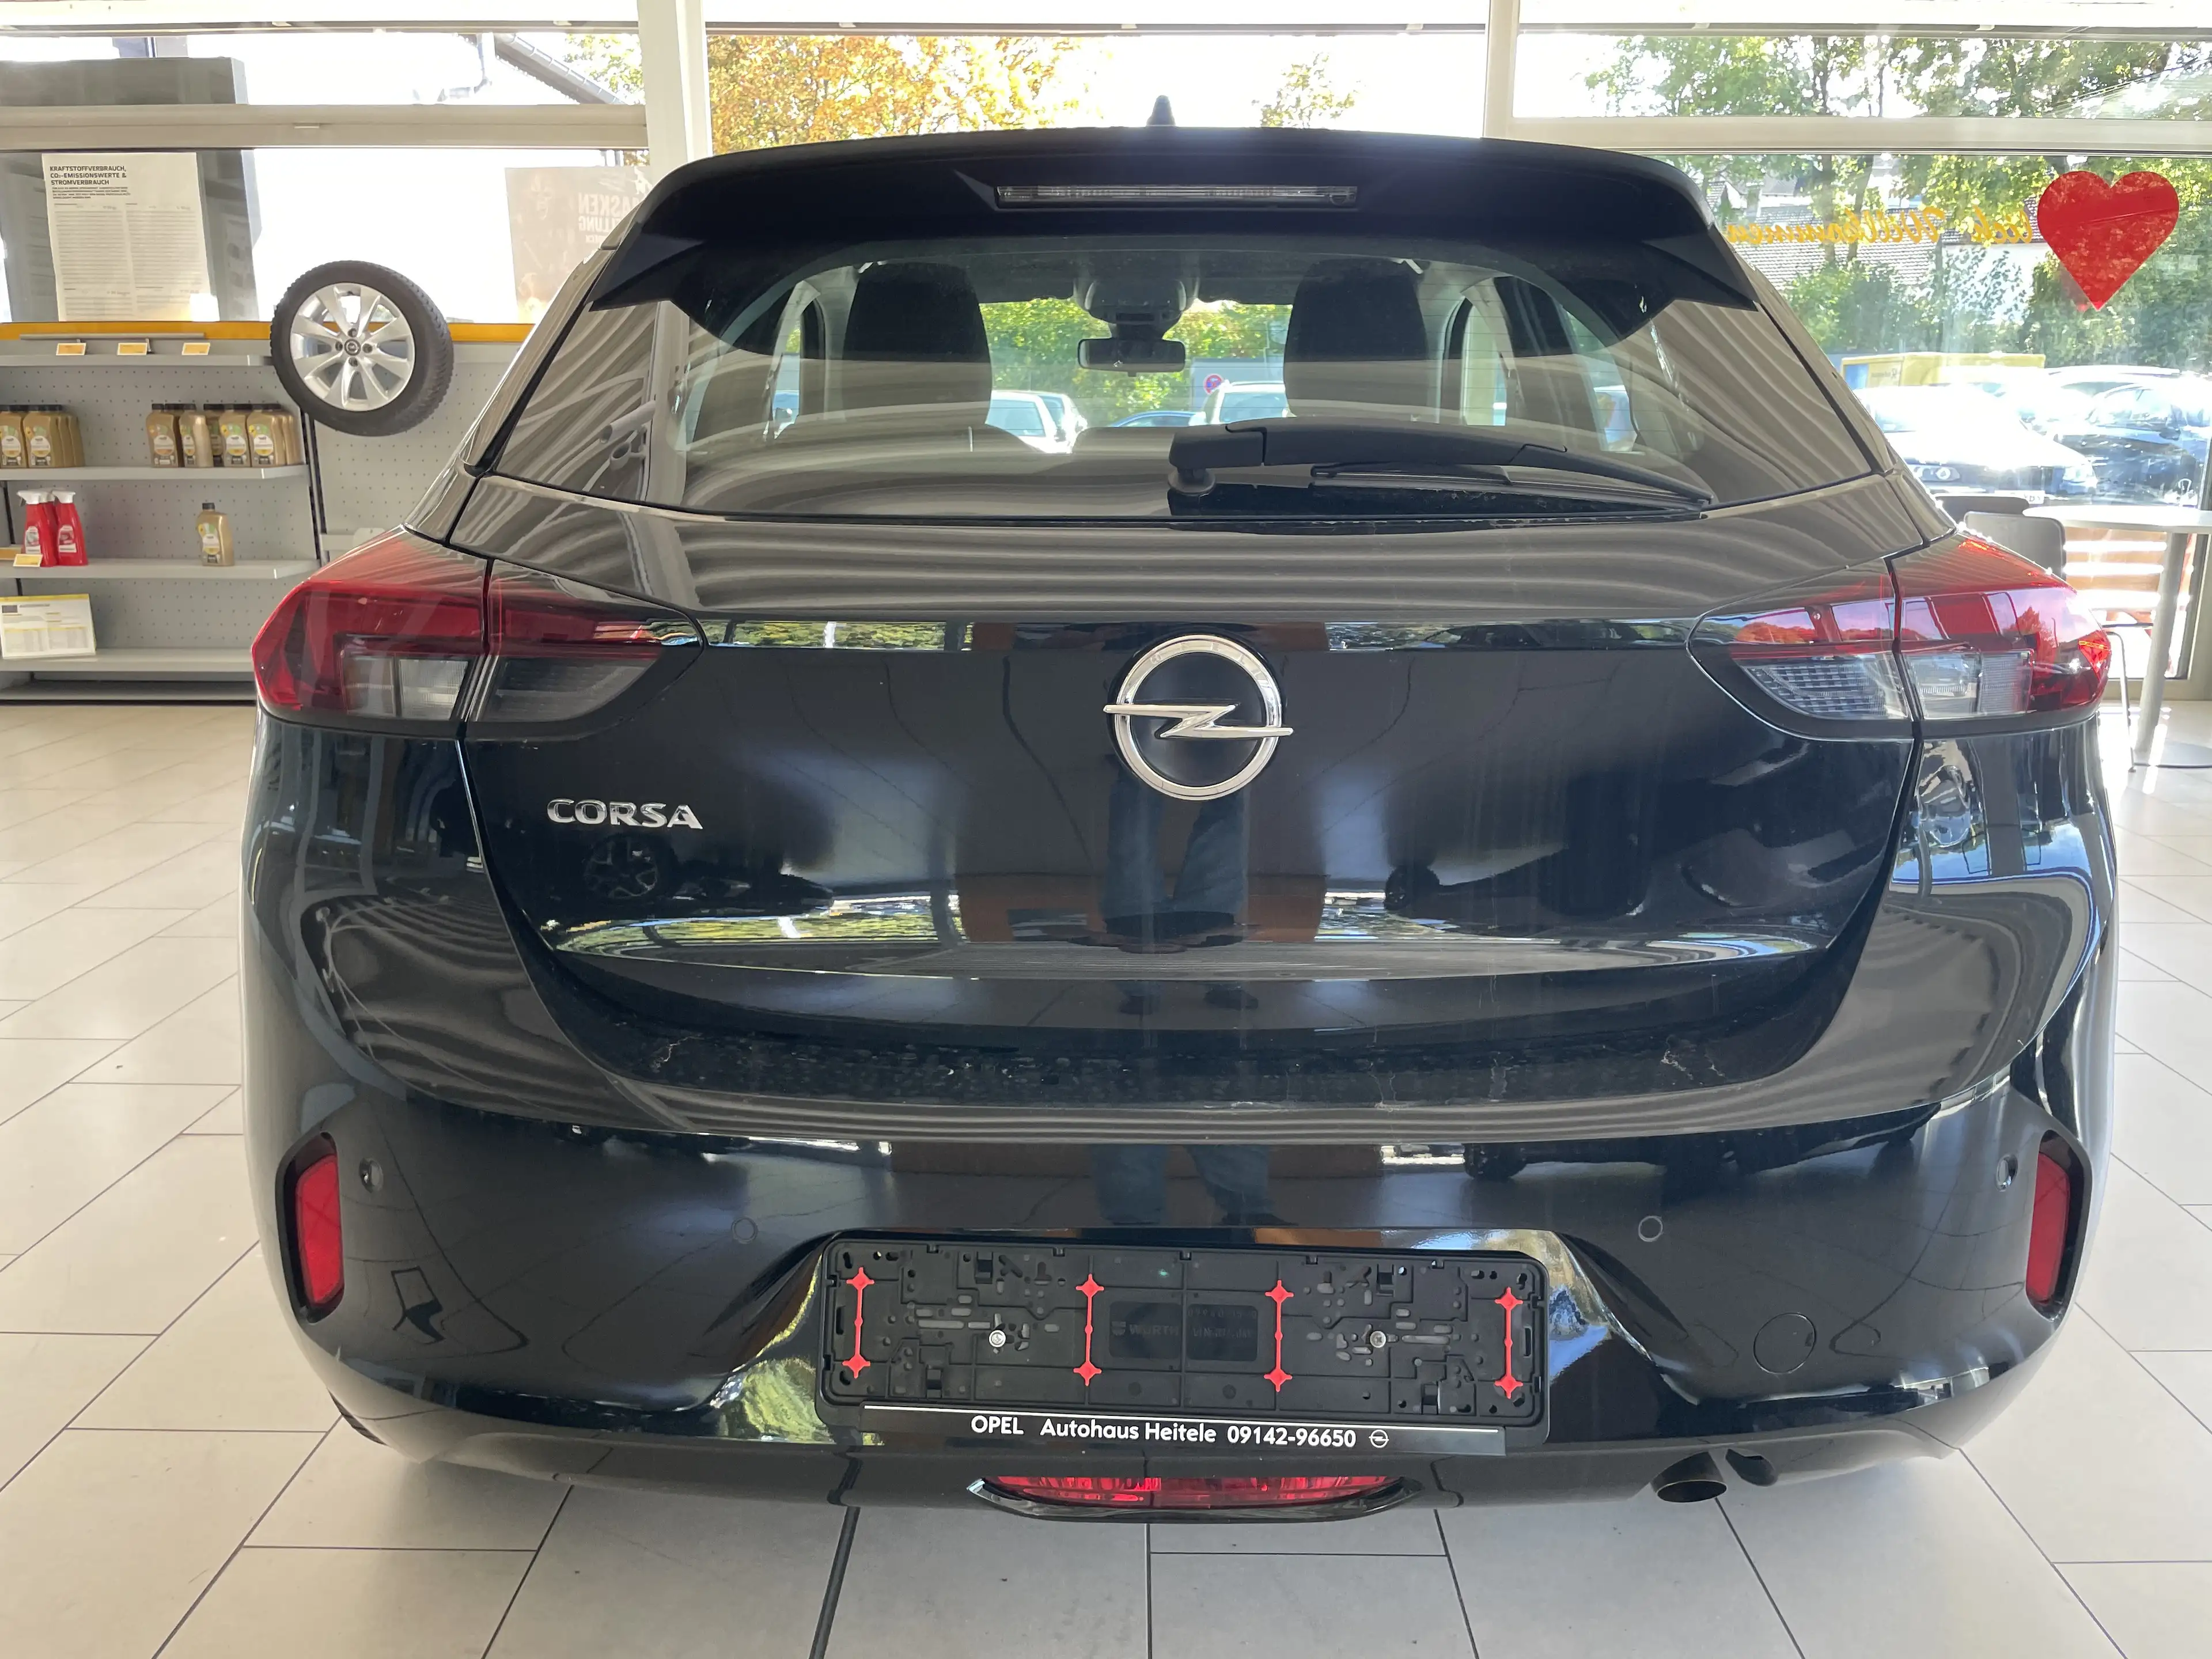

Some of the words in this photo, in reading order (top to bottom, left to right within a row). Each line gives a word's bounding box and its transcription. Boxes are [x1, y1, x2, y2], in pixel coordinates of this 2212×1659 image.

[547, 798, 703, 830] CORSA
[971, 1415, 1024, 1435] OPEL
[1040, 1418, 1139, 1440] Autohaus
[1145, 1422, 1217, 1442] Heitele
[1227, 1425, 1356, 1448] 09142-96650
